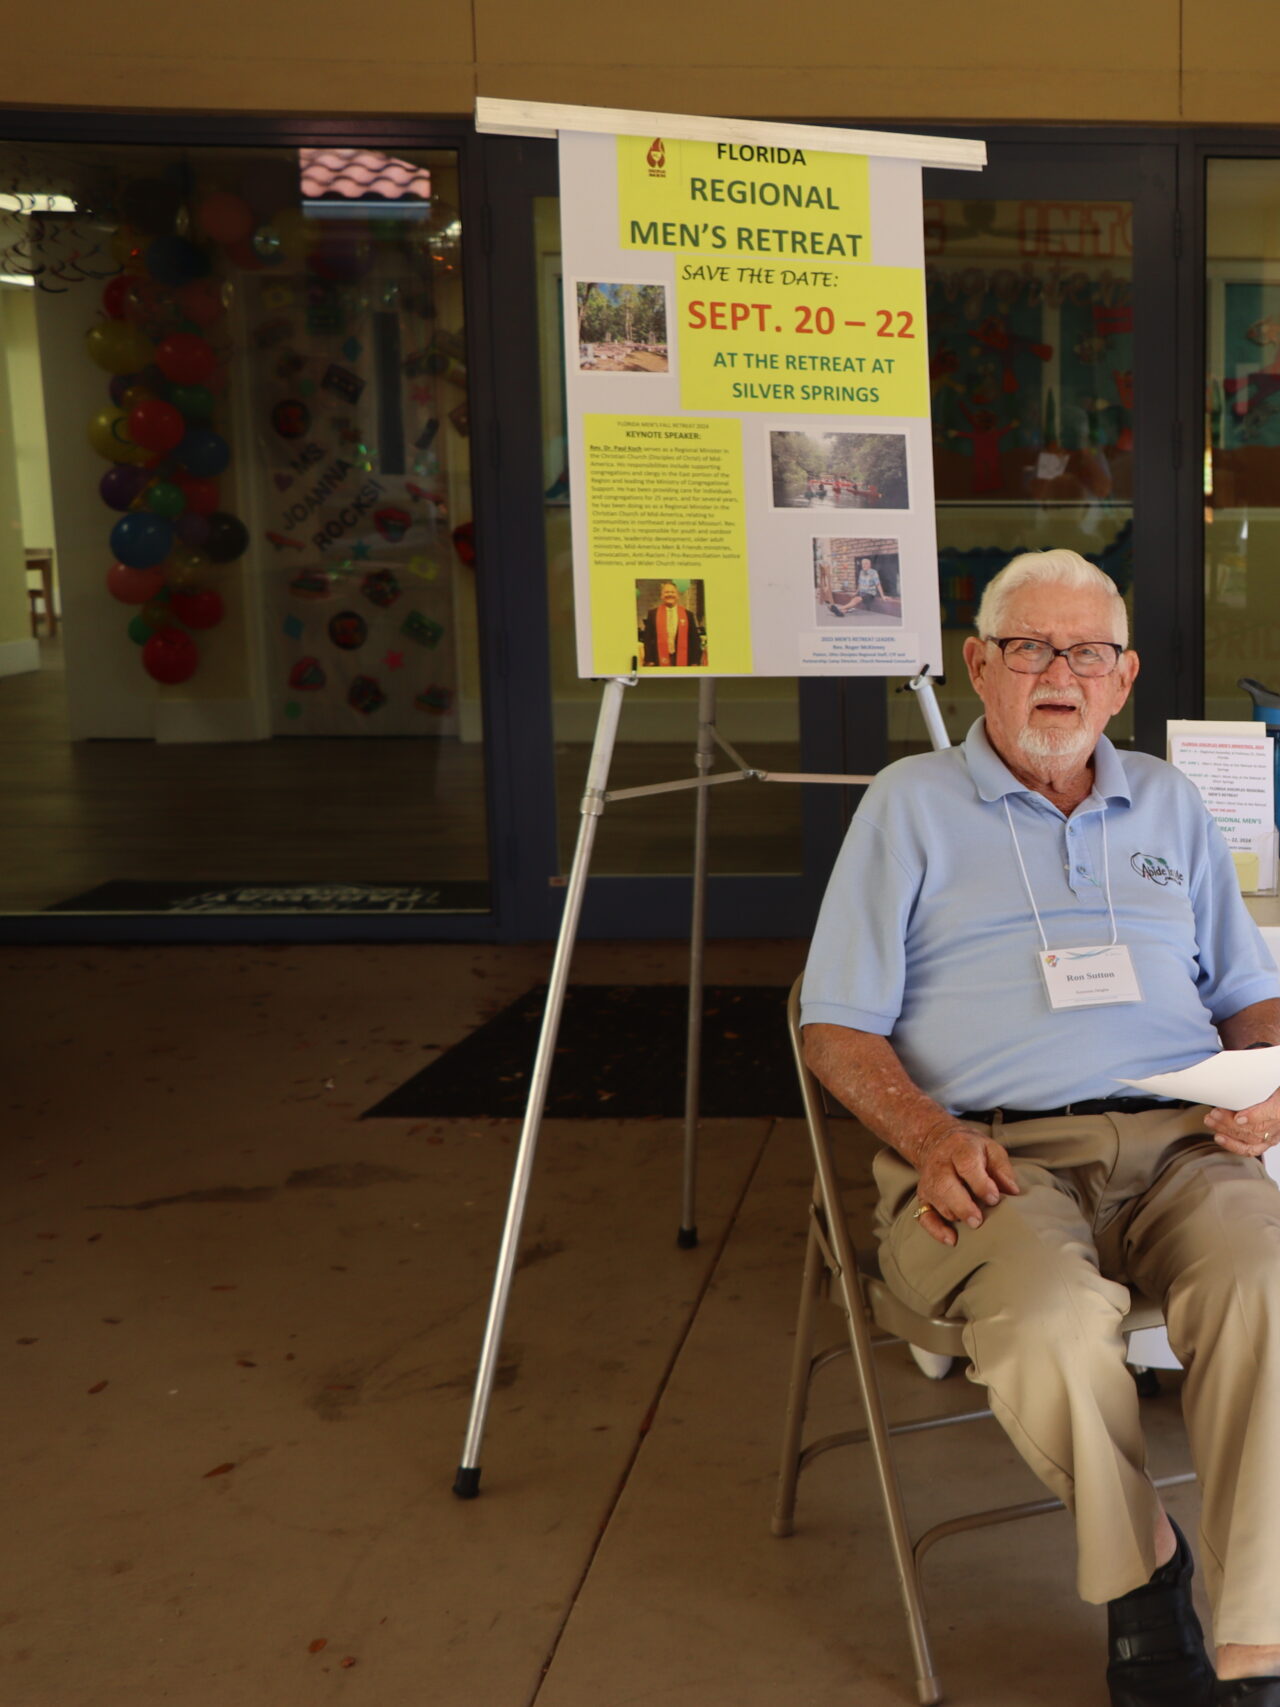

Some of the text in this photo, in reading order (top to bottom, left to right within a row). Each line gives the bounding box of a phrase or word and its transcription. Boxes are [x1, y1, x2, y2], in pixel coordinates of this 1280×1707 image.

[717, 142, 806, 166] FLORIDA
[690, 177, 840, 210] REGIONAL
[630, 221, 863, 257] MEN'S RETREAT
[681, 264, 838, 287] SAVE THE DATE:
[688, 300, 782, 332] SEPT.
[795, 305, 835, 335] 20
[875, 310, 915, 339] 22
[713, 352, 895, 374] AT THE RETREAT AT
[732, 382, 879, 402] SILVER SPRINGS
[626, 431, 701, 440] KEYNOTE SPEAKER:
[290, 443, 326, 474] MS
[282, 458, 353, 530] JOANNA
[1214, 816, 1241, 824] EGIONAL
[1142, 863, 1167, 878] Abide
[1066, 974, 1085, 982] Ron
